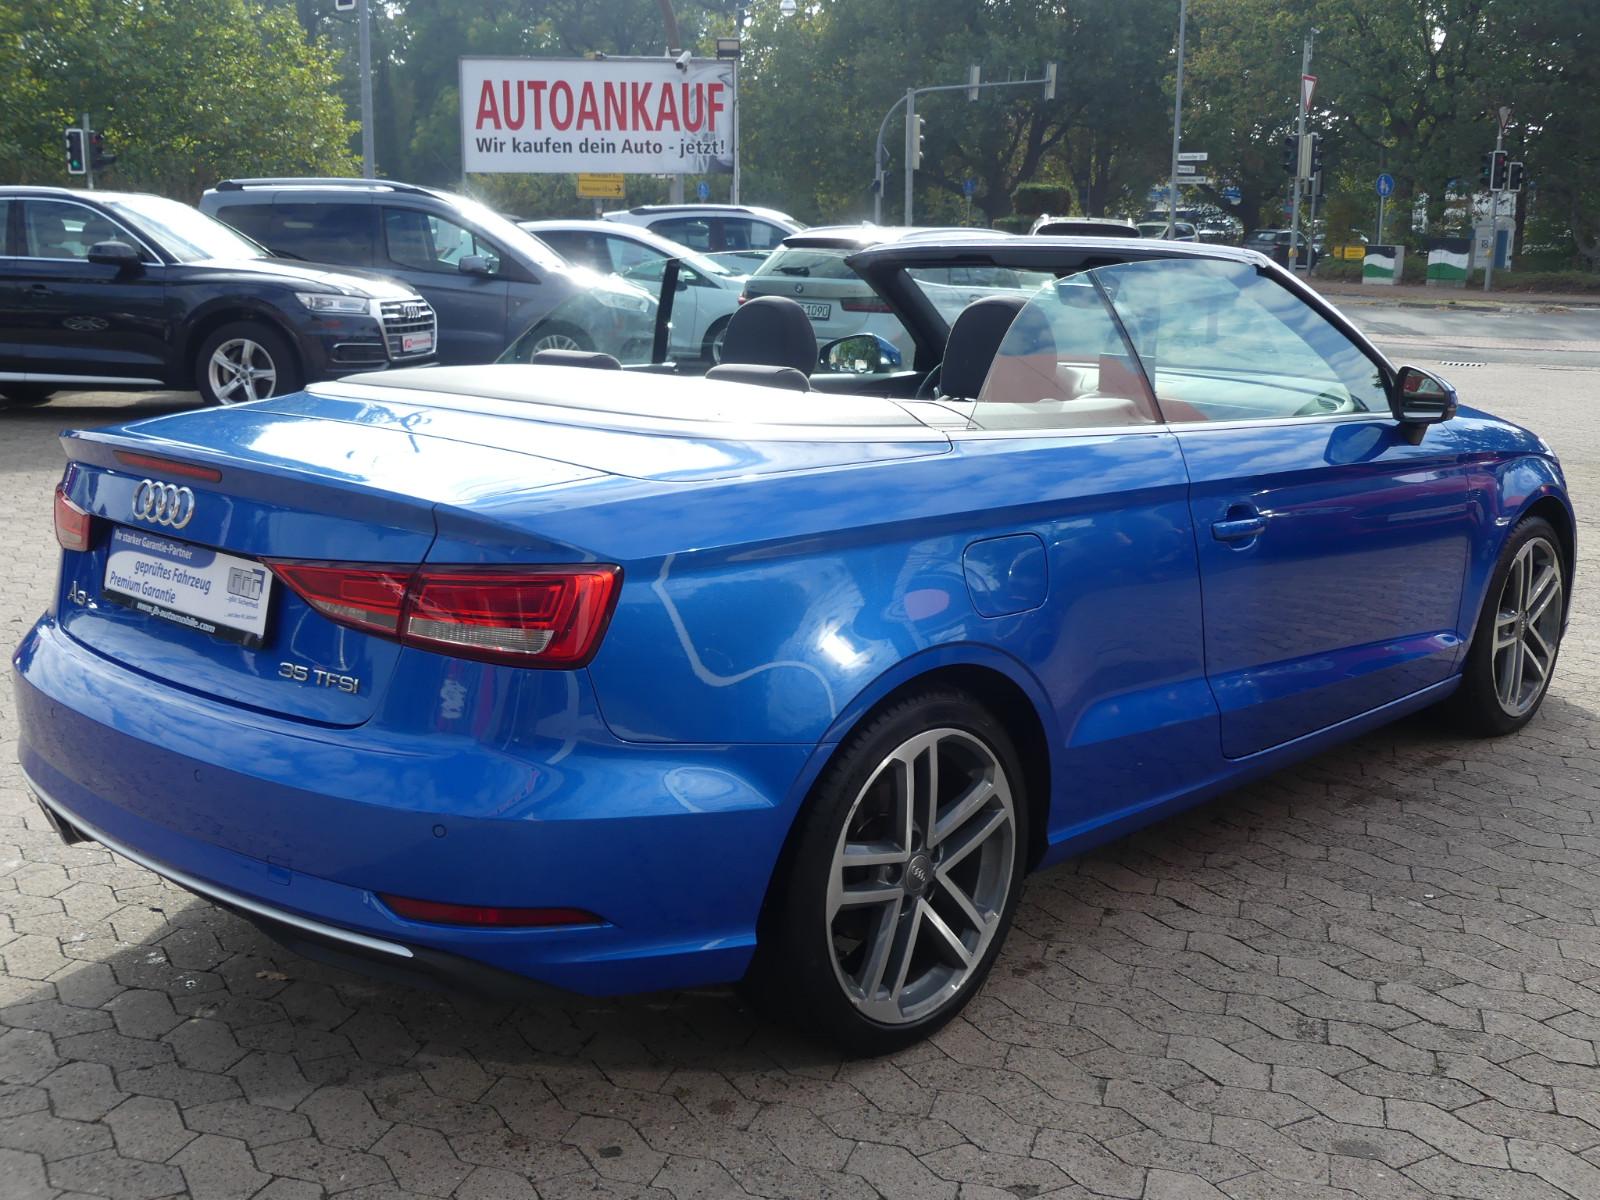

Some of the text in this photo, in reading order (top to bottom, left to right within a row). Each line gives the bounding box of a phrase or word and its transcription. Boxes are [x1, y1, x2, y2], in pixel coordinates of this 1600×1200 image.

[475, 80, 725, 132] AUTOANKAUF
[476, 137, 506, 153] Wir
[512, 137, 573, 154] kaufen
[578, 138, 616, 154] dein
[621, 139, 663, 154] Auto
[679, 139, 725, 158] jetzt!
[122, 533, 142, 546] starker
[141, 536, 193, 560] Garantie-Partner
[109, 570, 176, 604] Premium Garantie
[134, 560, 171, 581] geprüftes
[171, 567, 212, 595] Fahrzeug
[278, 661, 360, 695] 35 TFSI
